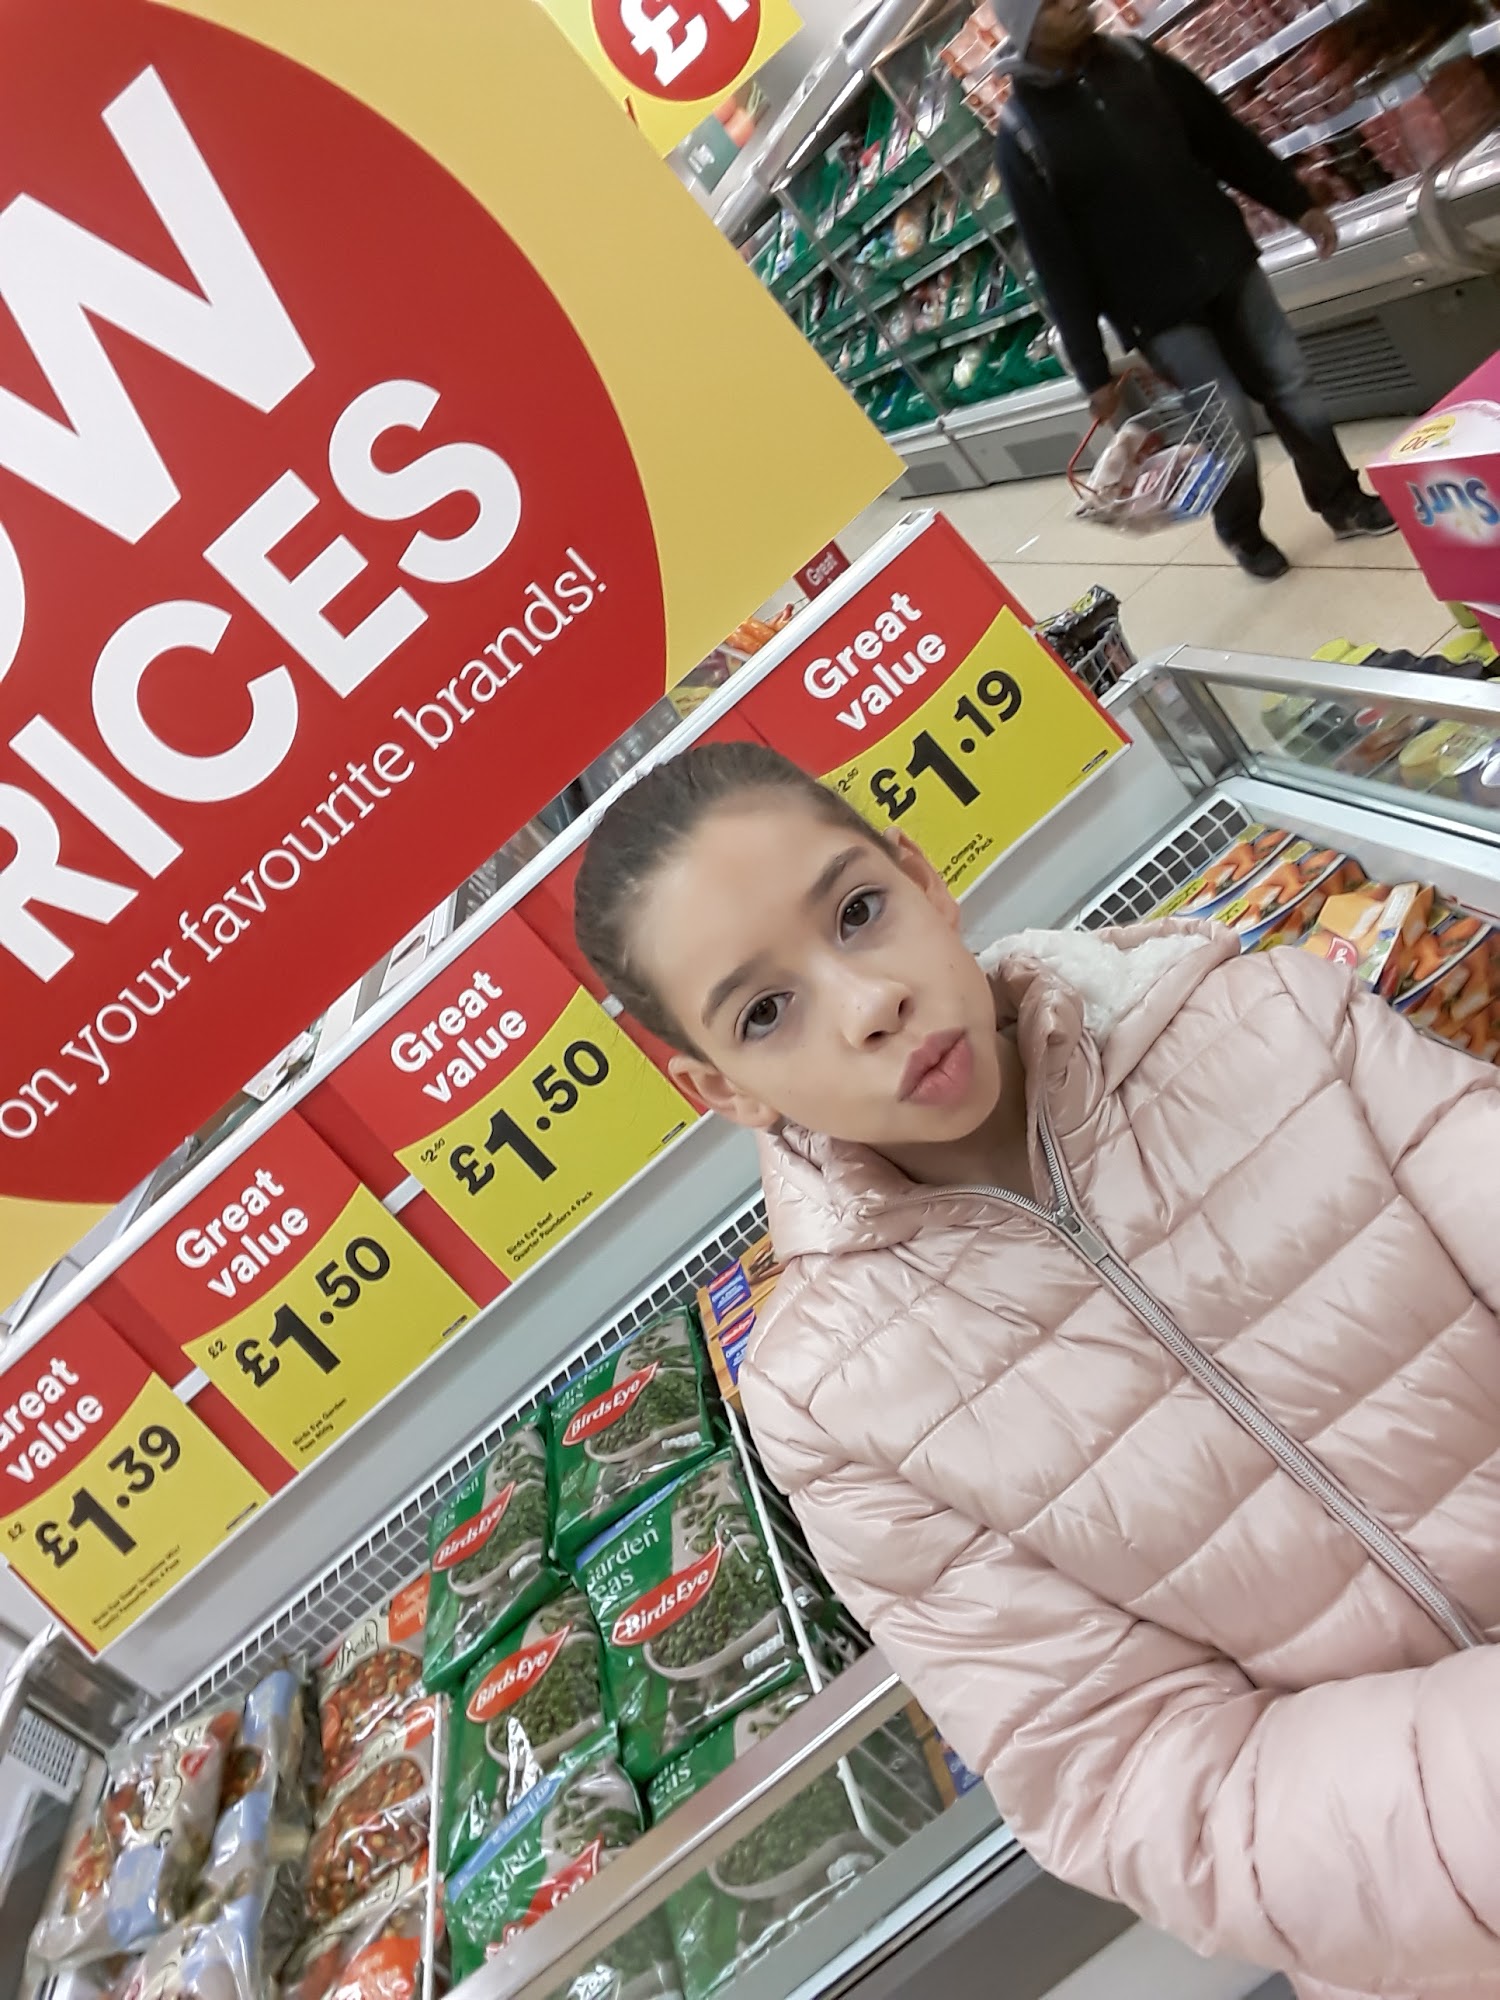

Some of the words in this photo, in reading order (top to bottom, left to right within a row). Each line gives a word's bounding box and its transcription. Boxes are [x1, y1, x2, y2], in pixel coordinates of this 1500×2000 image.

[1404, 477, 1500, 526] Surf
[806, 552, 837, 587] Great
[803, 592, 922, 699] Great
[835, 634, 946, 731] value
[870, 670, 1022, 822] £1.19
[0, 1068, 77, 1138] on
[60, 947, 191, 1085] your
[178, 742, 415, 963] favourite
[393, 547, 608, 750] brands!
[950, 839, 978, 865] Omega
[975, 837, 993, 855] Pack
[390, 970, 503, 1073] Great
[422, 1010, 527, 1103] value
[449, 1040, 610, 1196] £1.50
[175, 1167, 286, 1269] Great
[207, 1207, 309, 1298] value
[506, 1238, 525, 1255] Birds
[524, 1227, 538, 1240] Eye
[537, 1213, 553, 1228] Beef
[513, 1238, 540, 1262] Quarter
[539, 1210, 571, 1238] Pounders
[576, 1190, 593, 1206] Pack
[207, 1339, 227, 1360] £2
[235, 1236, 391, 1388] £1.50
[6, 1395, 104, 1483] value
[35, 1425, 181, 1568] £1.39
[594, 1568, 635, 1600] eas
